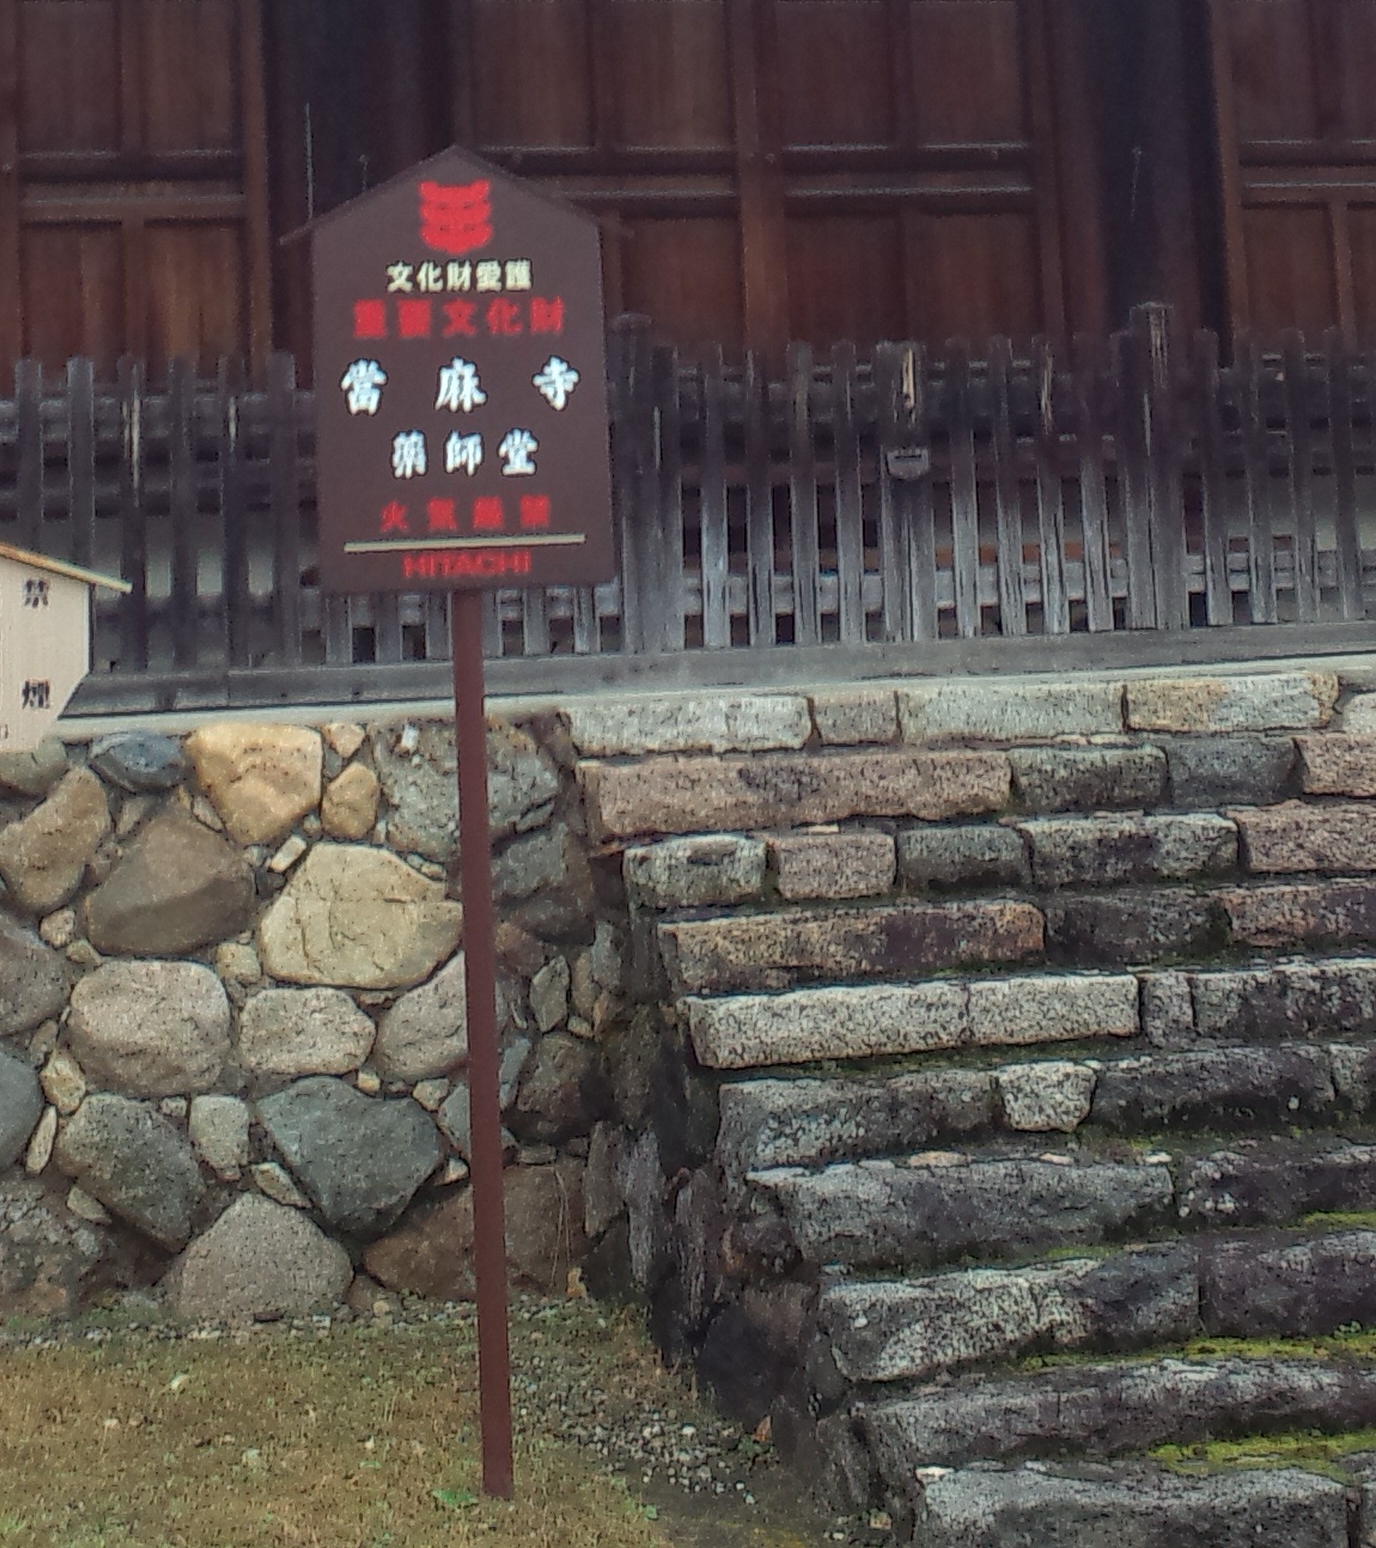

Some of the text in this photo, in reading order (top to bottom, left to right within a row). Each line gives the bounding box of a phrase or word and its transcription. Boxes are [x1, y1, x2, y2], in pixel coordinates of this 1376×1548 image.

[386, 259, 533, 292] 文化財愛護
[403, 553, 531, 578] HITACHI
[22, 579, 50, 710] 禁煙
